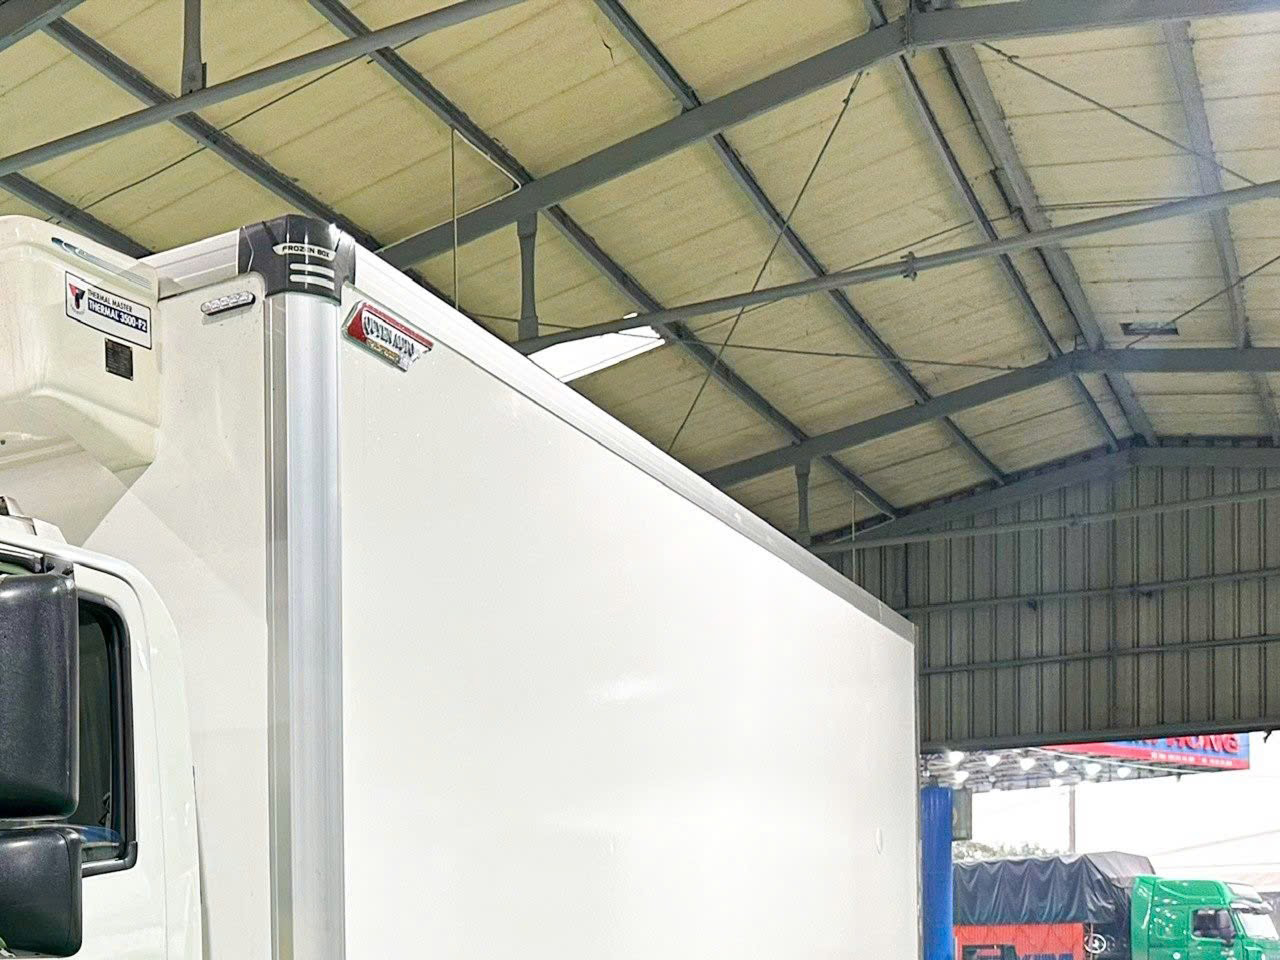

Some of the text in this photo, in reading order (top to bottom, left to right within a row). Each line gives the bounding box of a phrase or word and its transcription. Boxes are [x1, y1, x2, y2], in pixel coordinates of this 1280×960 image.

[282, 245, 315, 254] FROZN
[88, 289, 132, 313] THERMAL MASTER
[88, 300, 119, 320] THERMAL
